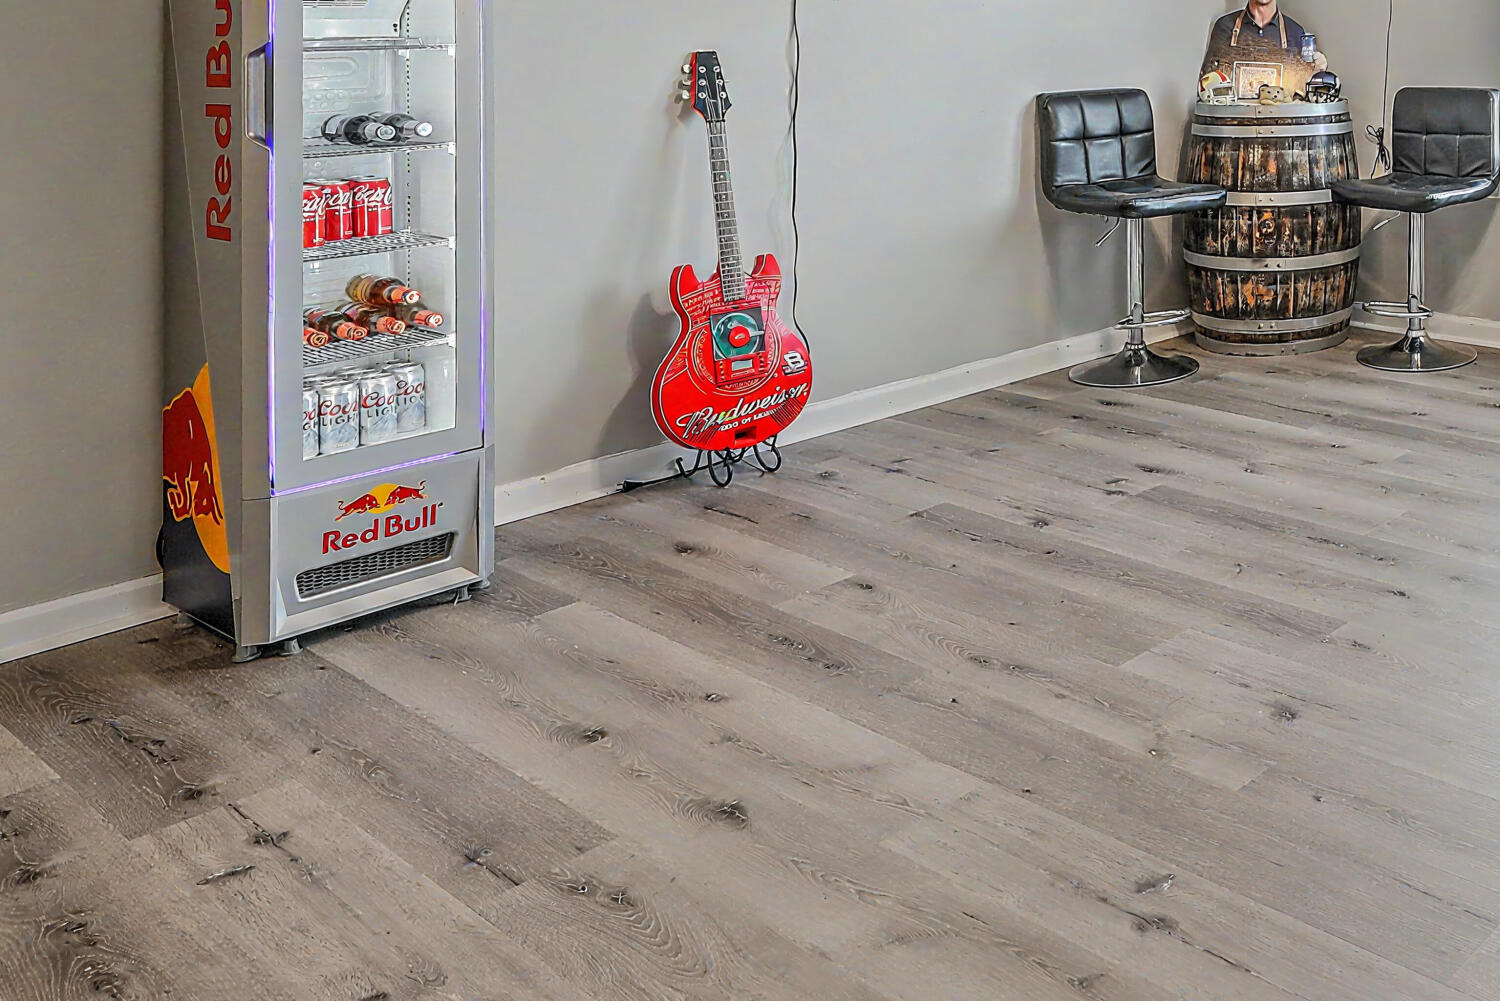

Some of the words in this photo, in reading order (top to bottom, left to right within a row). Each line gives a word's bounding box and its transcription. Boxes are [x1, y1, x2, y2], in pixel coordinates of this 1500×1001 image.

[205, 104, 233, 243] Red
[675, 382, 809, 439] Budweiser
[321, 518, 380, 555] Red
[383, 503, 437, 538] Bull
